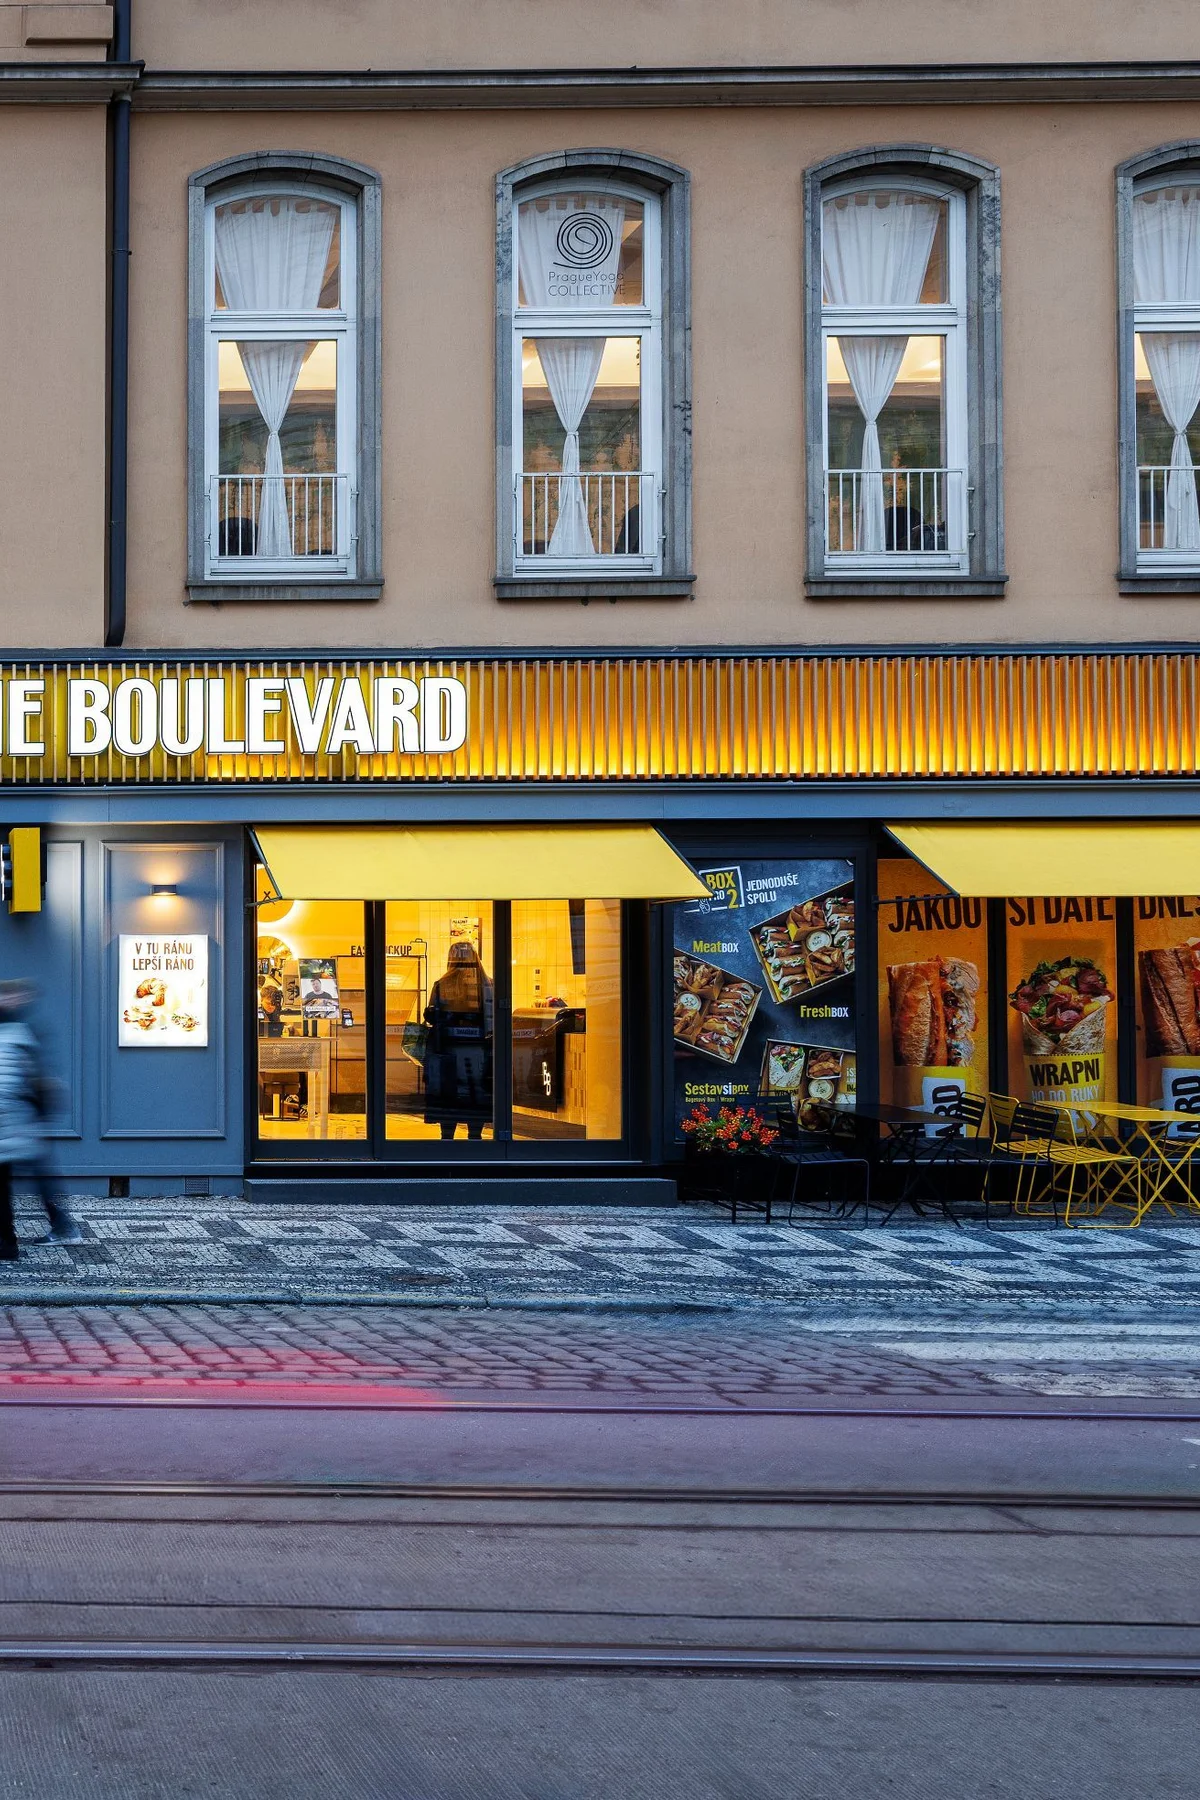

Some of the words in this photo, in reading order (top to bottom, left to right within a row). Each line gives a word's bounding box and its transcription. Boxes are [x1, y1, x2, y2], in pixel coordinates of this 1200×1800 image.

[548, 271, 624, 284] PragueYoga
[548, 284, 626, 296] COLLECTIVE
[67, 677, 468, 757] BOULEVARD
[705, 871, 736, 890] BOX
[745, 872, 800, 892] JEDNODUŠE
[726, 889, 739, 909] 2
[747, 890, 777, 905] SPOLU
[888, 894, 982, 933] JAKOU
[135, 942, 142, 955] V
[147, 942, 159, 955] TU
[163, 939, 192, 955] RÁNU
[350, 945, 366, 956] EA
[692, 940, 739, 953] MeatBOX
[132, 955, 161, 971] LEPŠÍ
[165, 955, 194, 971] RÁNO
[800, 1005, 849, 1018] FreshBOX
[1029, 1058, 1100, 1087] WRAPNI
[1070, 1085, 1099, 1102] RUKY
